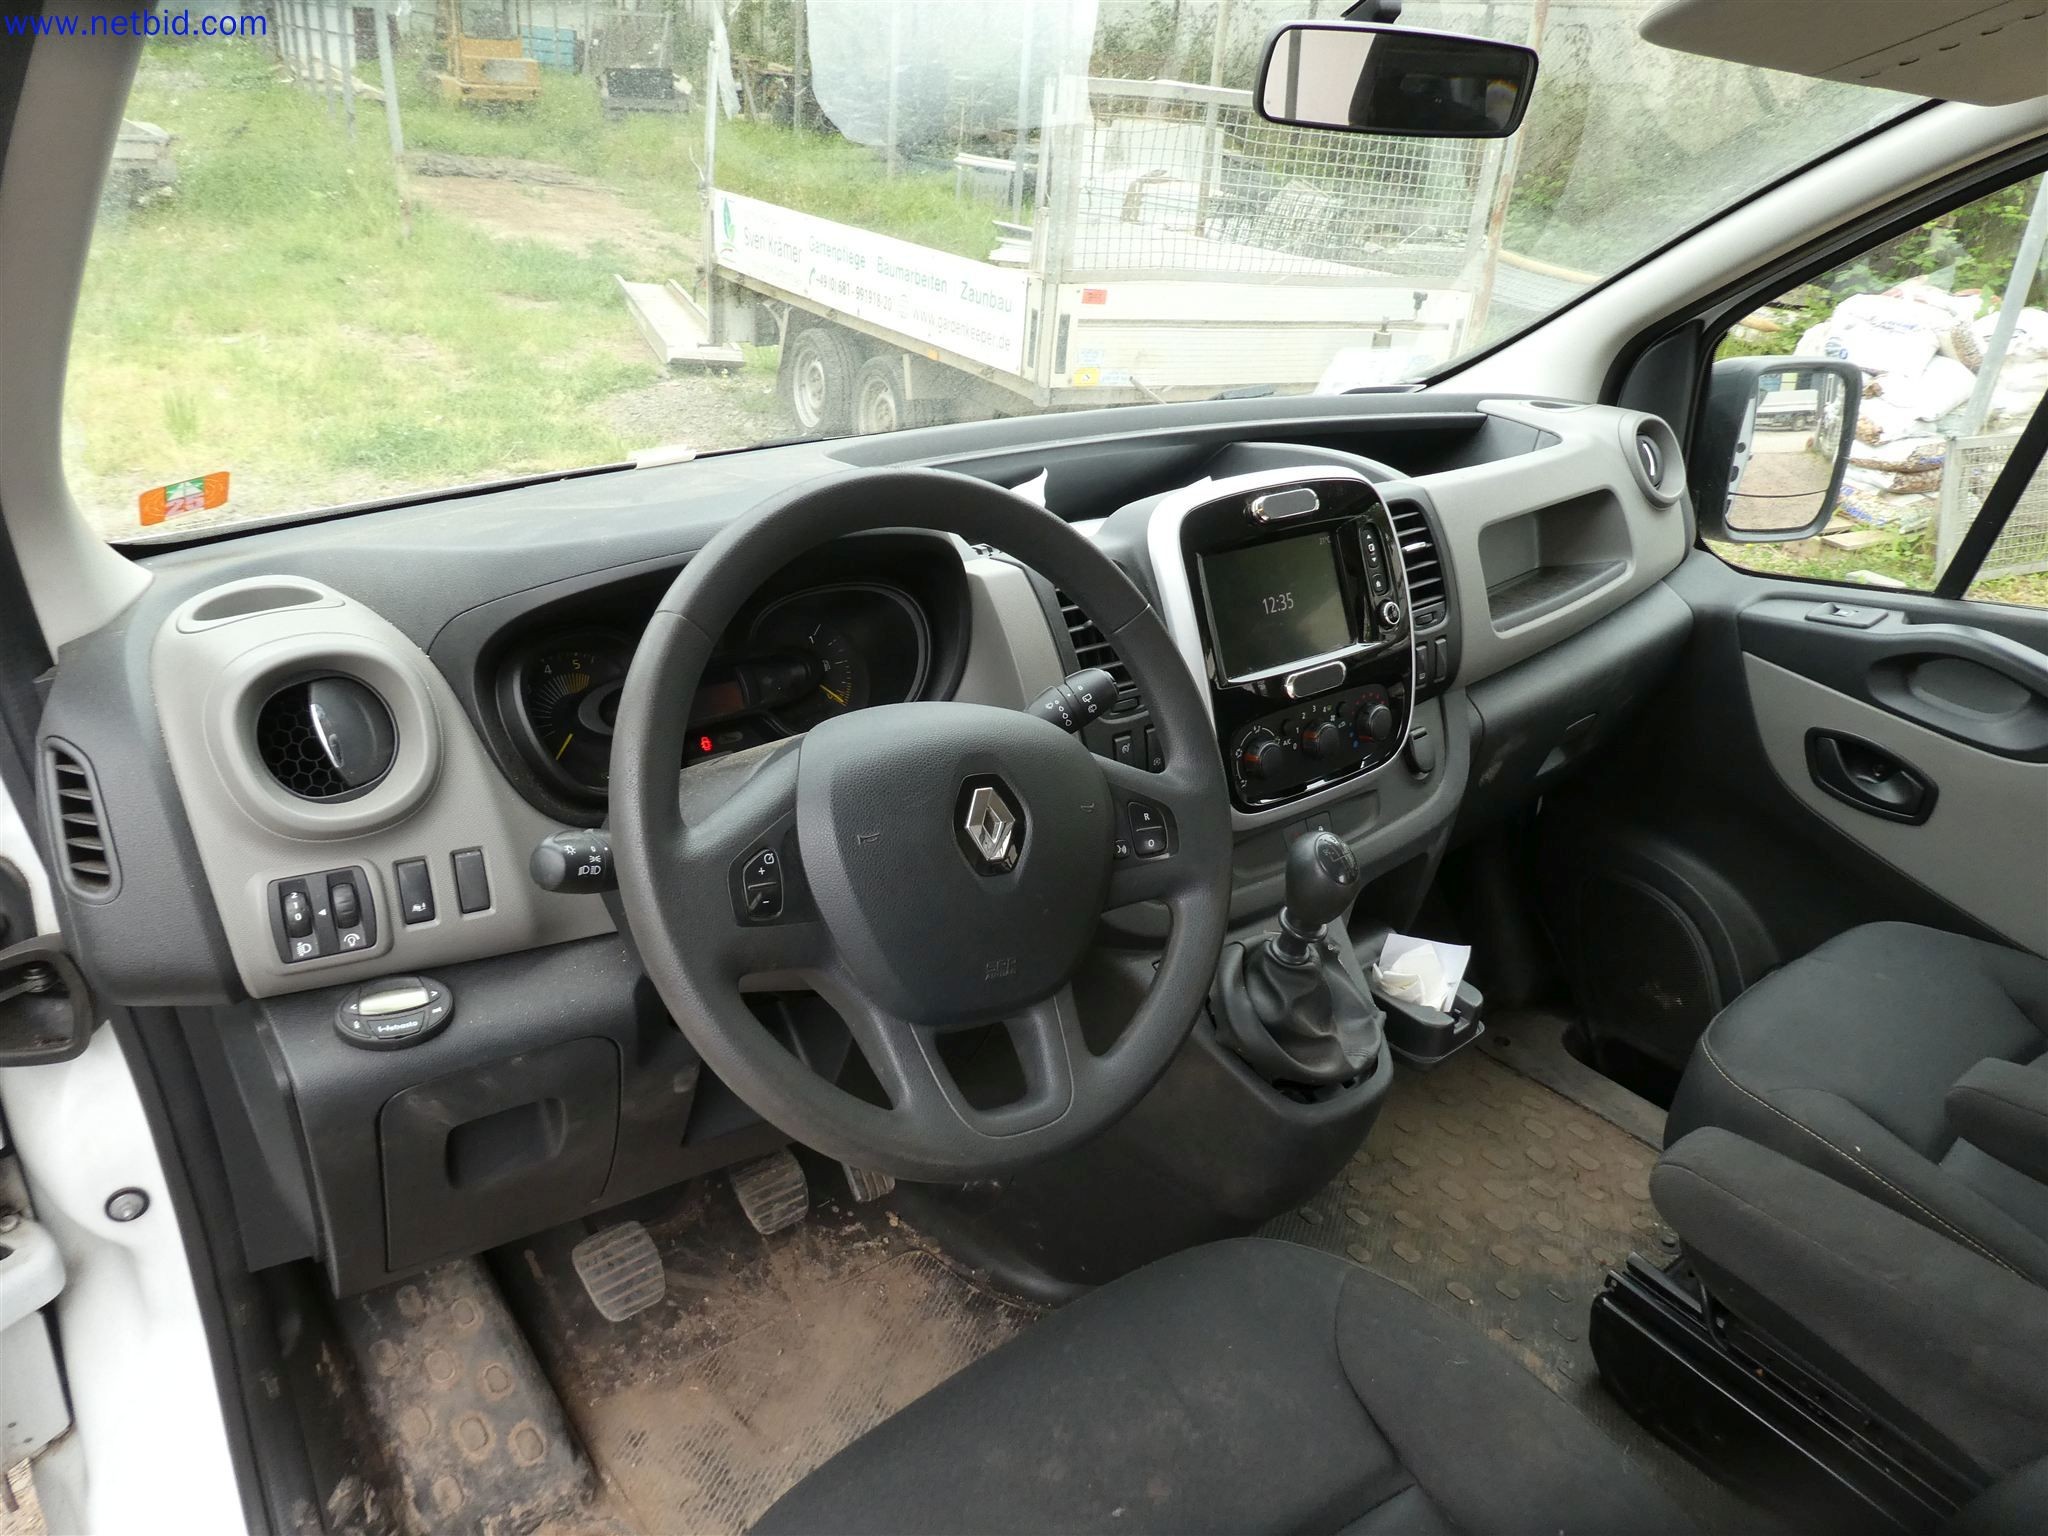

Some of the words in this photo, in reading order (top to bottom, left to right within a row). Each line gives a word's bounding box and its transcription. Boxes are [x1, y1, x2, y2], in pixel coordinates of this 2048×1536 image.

[743, 226, 765, 249] Sven
[768, 231, 802, 263] Krämer
[808, 234, 866, 270] Gartenpflege
[876, 256, 948, 294] Baumarbeiten
[959, 280, 1014, 313] Zaunbau
[912, 308, 1012, 352] www.gardenkeeper.de
[1262, 592, 1294, 615] 12:35
[544, 664, 552, 674] 4
[571, 658, 581, 670] 5
[1301, 712, 1306, 720] 2
[1143, 812, 1151, 821] R
[293, 901, 299, 909] 1
[294, 912, 302, 921] 0
